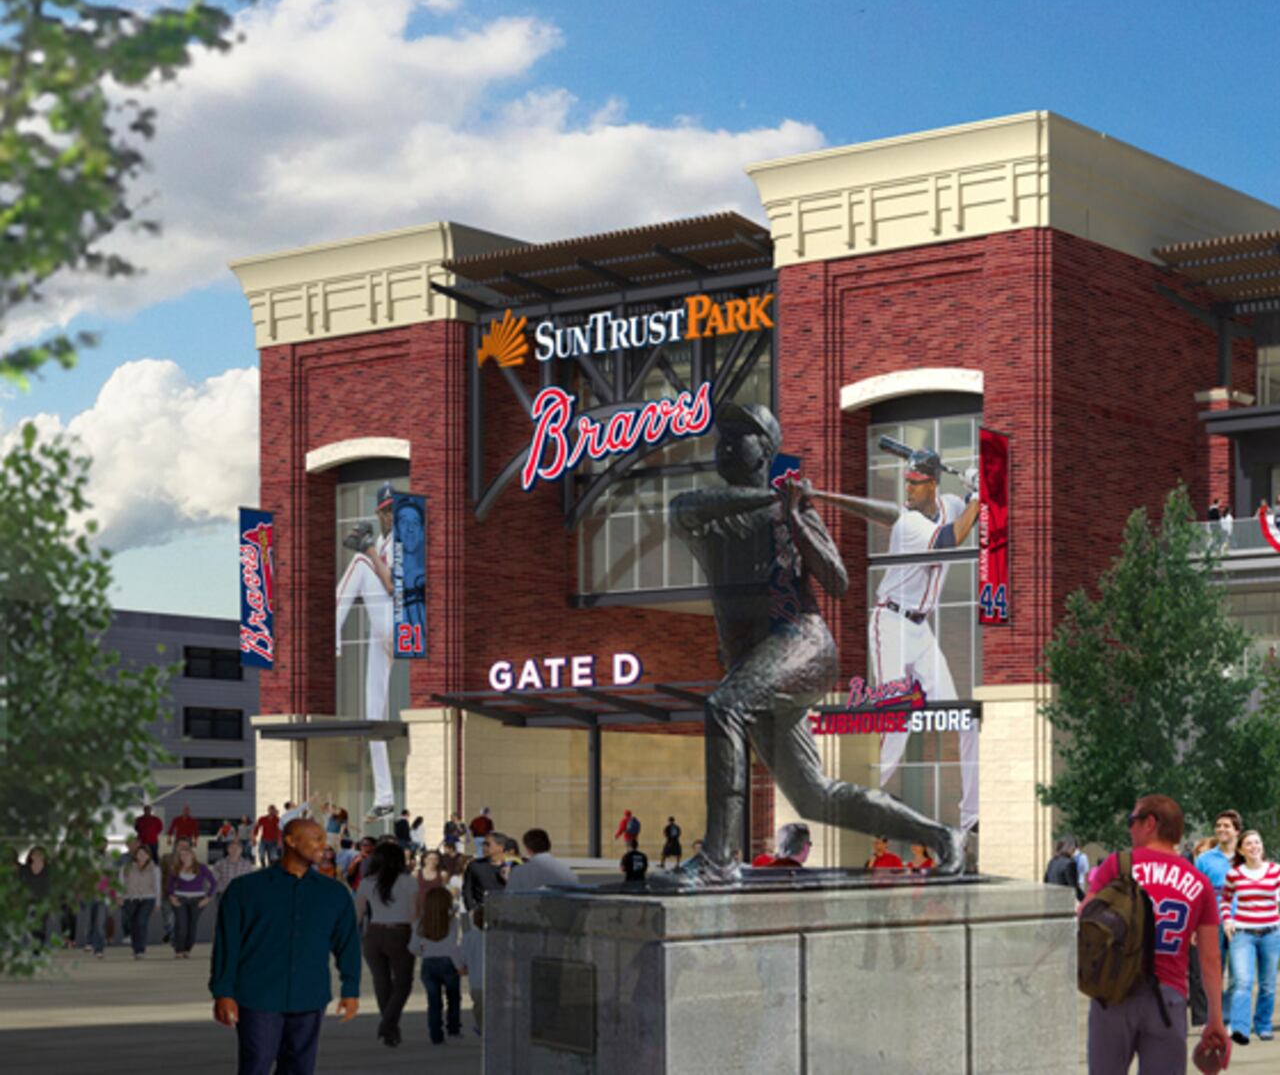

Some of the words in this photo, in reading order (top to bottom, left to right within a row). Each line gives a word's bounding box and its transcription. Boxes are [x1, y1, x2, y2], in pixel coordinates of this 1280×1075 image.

[521, 381, 711, 490] Braves
[240, 543, 274, 662] Braves
[979, 583, 1009, 619] 44
[397, 624, 423, 653] 21
[488, 655, 595, 693] GATE
[612, 652, 643, 686] D
[910, 707, 973, 733] STORE
[1131, 861, 1204, 901] EYWARD
[1150, 898, 1190, 955] 2
